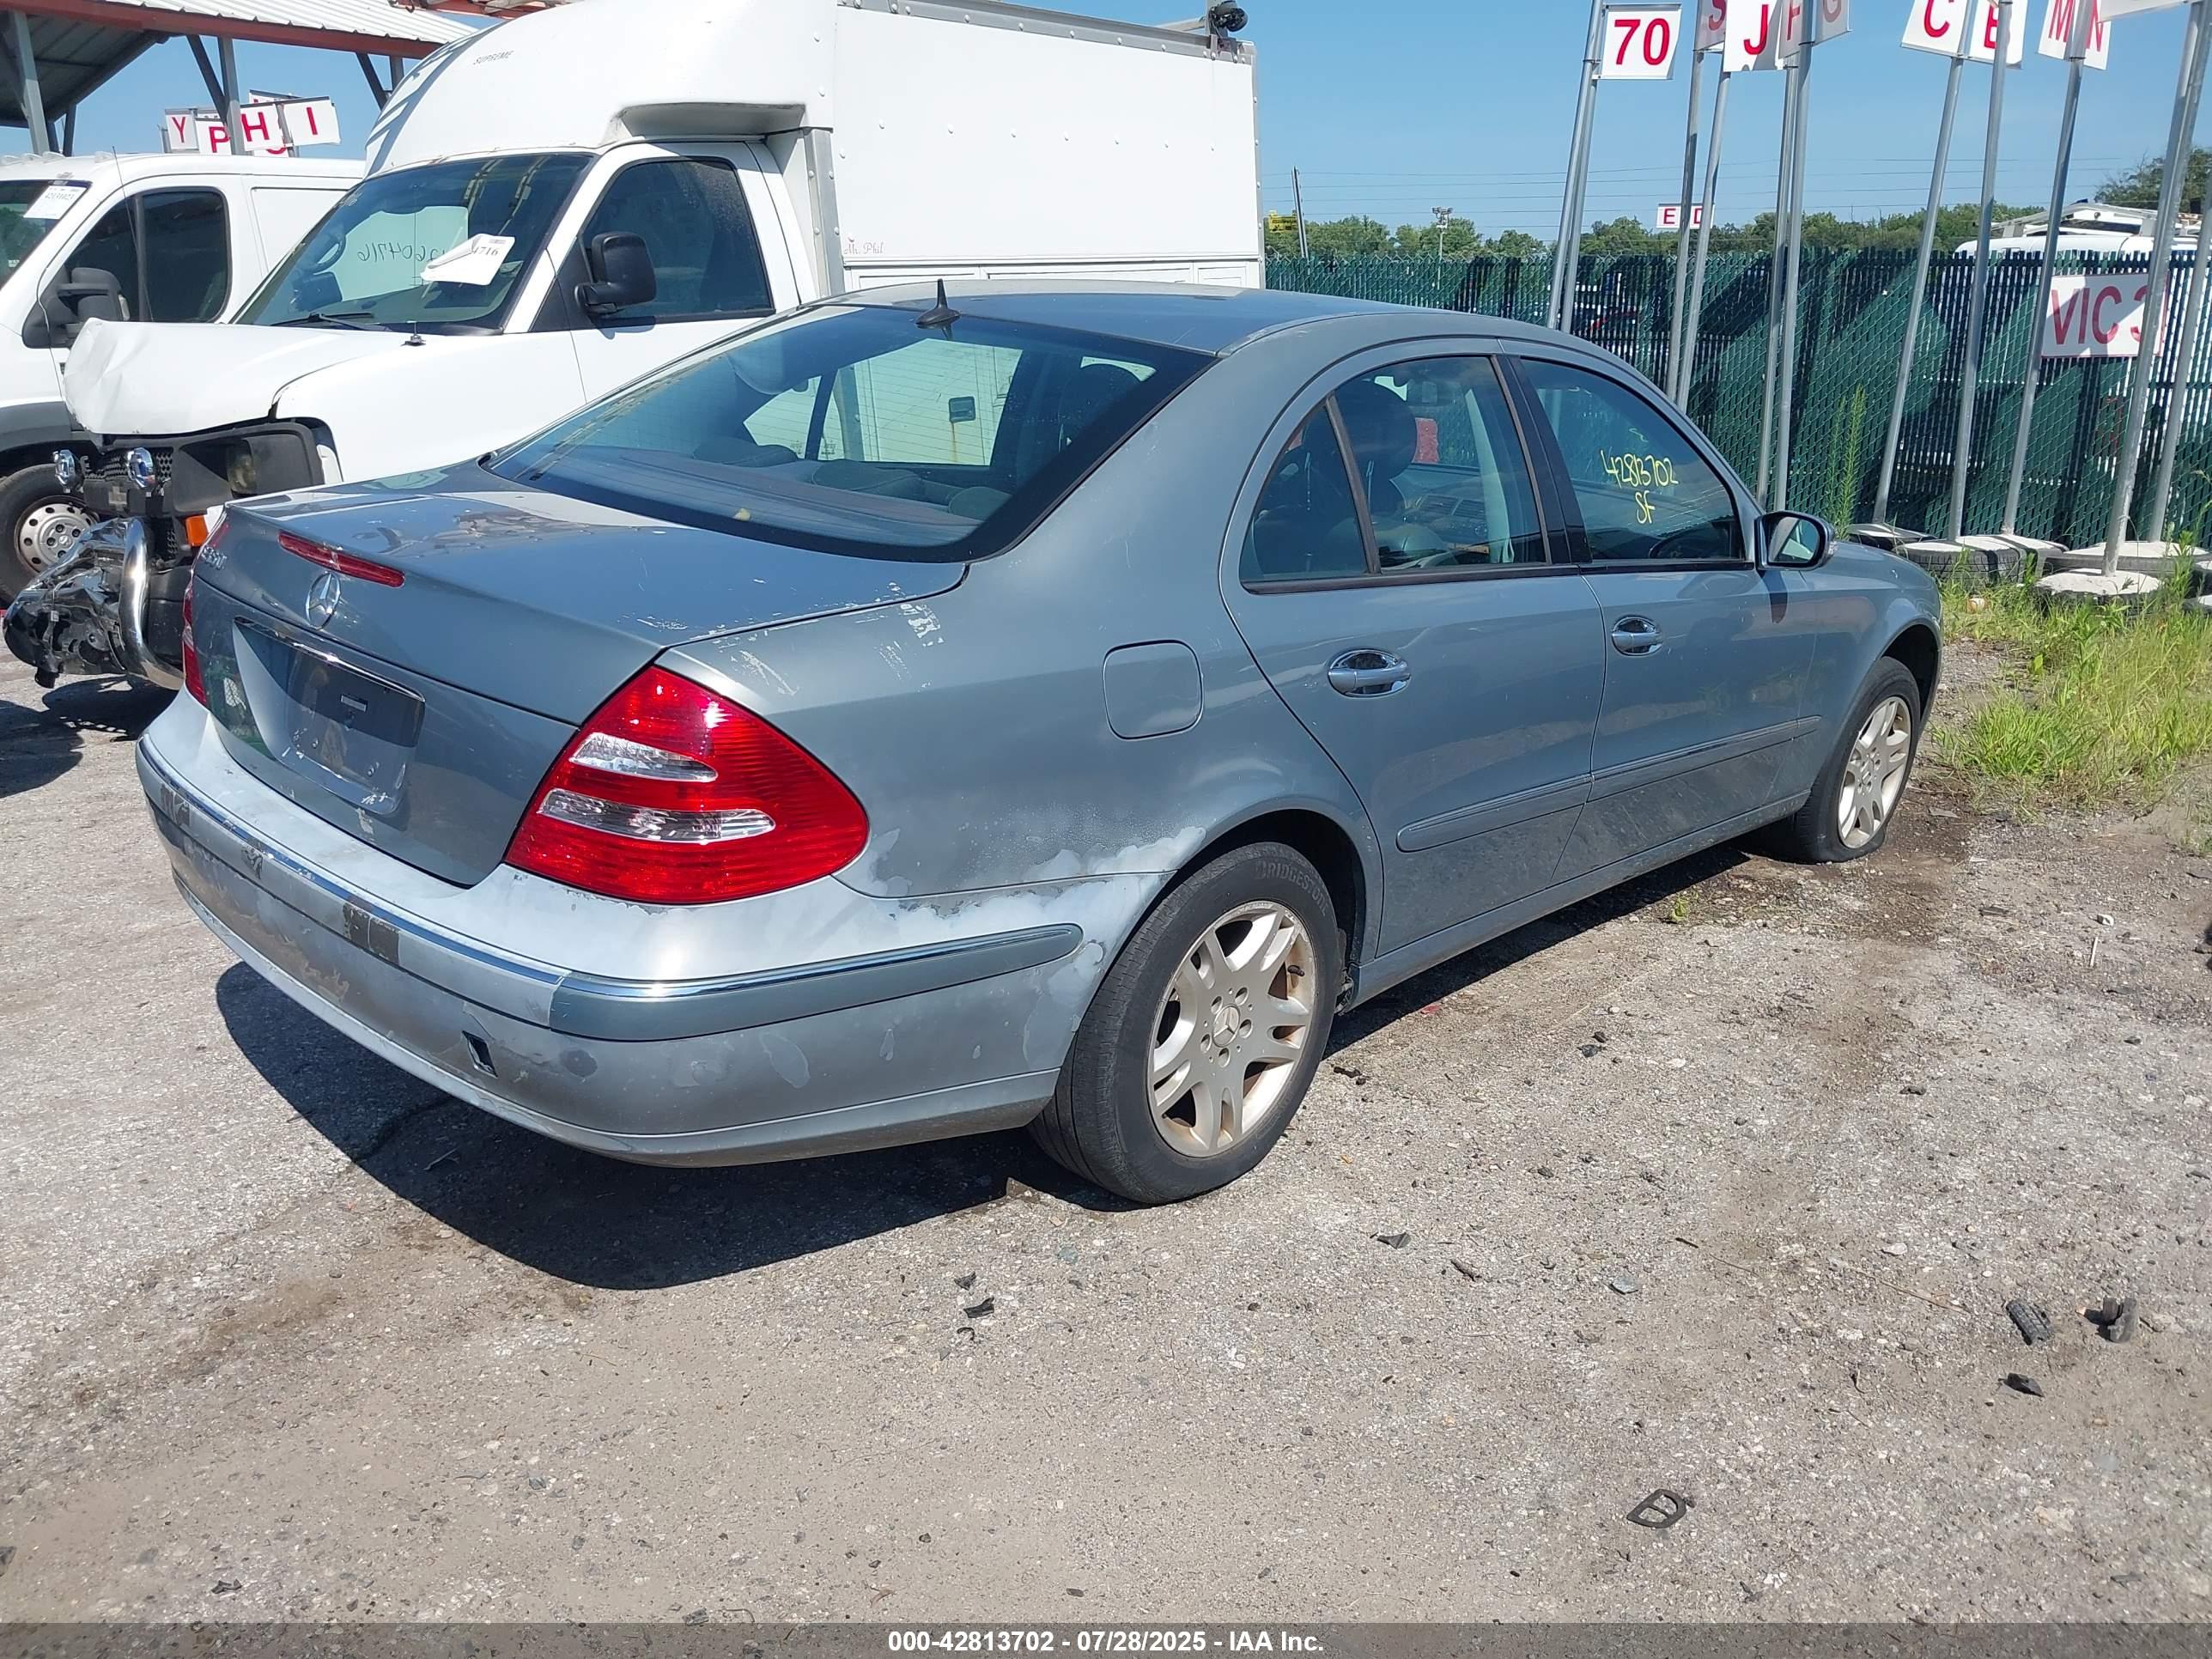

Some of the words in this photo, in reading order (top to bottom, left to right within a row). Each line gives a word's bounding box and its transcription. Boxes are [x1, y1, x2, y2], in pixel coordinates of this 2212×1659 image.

[1743, 4, 1768, 55] J
[1923, 0, 1950, 38] C
[473, 51, 514, 65] SUPREME
[1614, 18, 1670, 65] 70
[172, 117, 185, 143] Y
[241, 112, 270, 142] H
[307, 106, 319, 135] I
[209, 126, 231, 153] P
[2051, 286, 2122, 344] VIC
[1601, 450, 1679, 489] 42813702
[1635, 490, 1656, 524] SF
[1255, 860, 1328, 917] BRIDGESTONE
